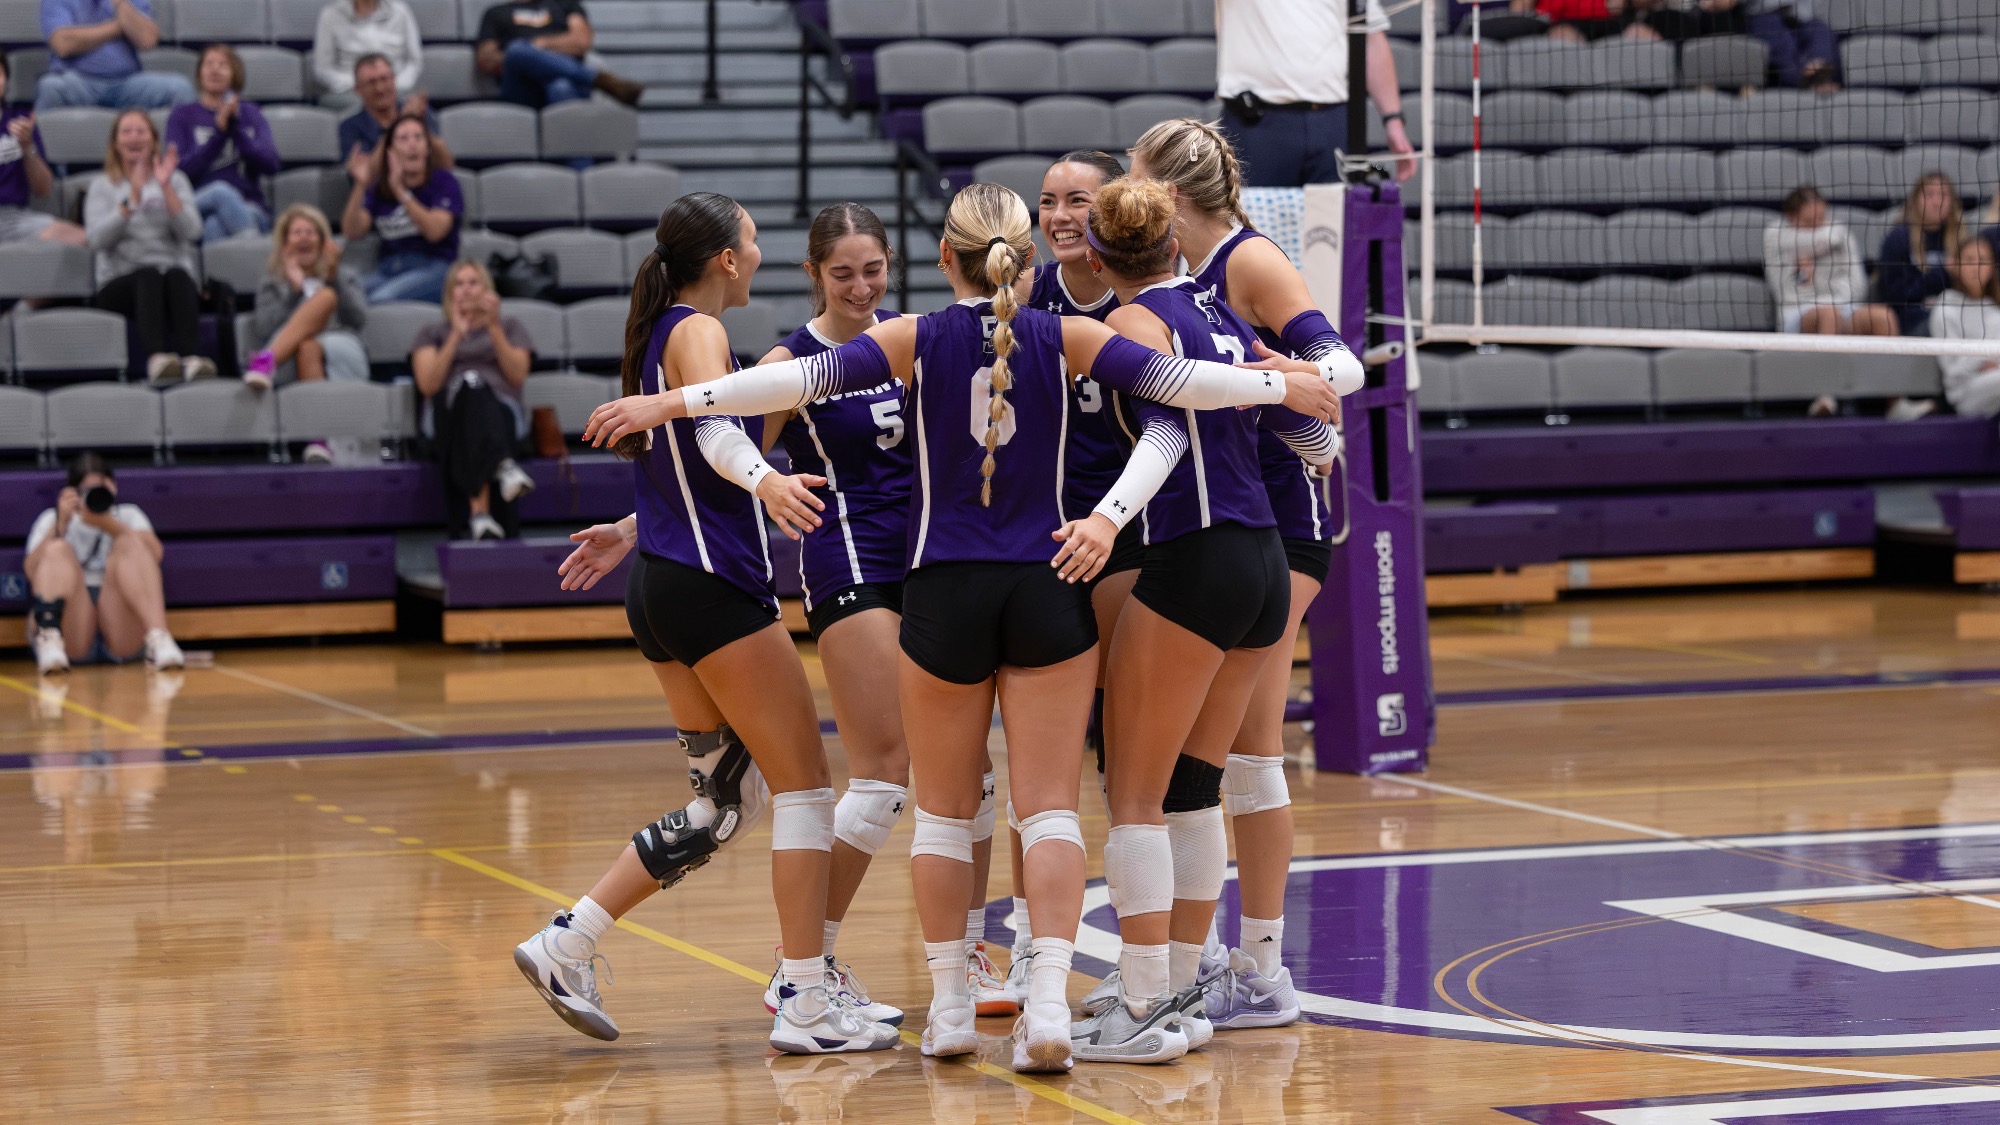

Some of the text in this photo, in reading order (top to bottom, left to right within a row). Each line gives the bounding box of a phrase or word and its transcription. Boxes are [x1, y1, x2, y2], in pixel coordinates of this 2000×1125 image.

[869, 398, 905, 451] 5
[1374, 530, 1400, 675] sports imports
